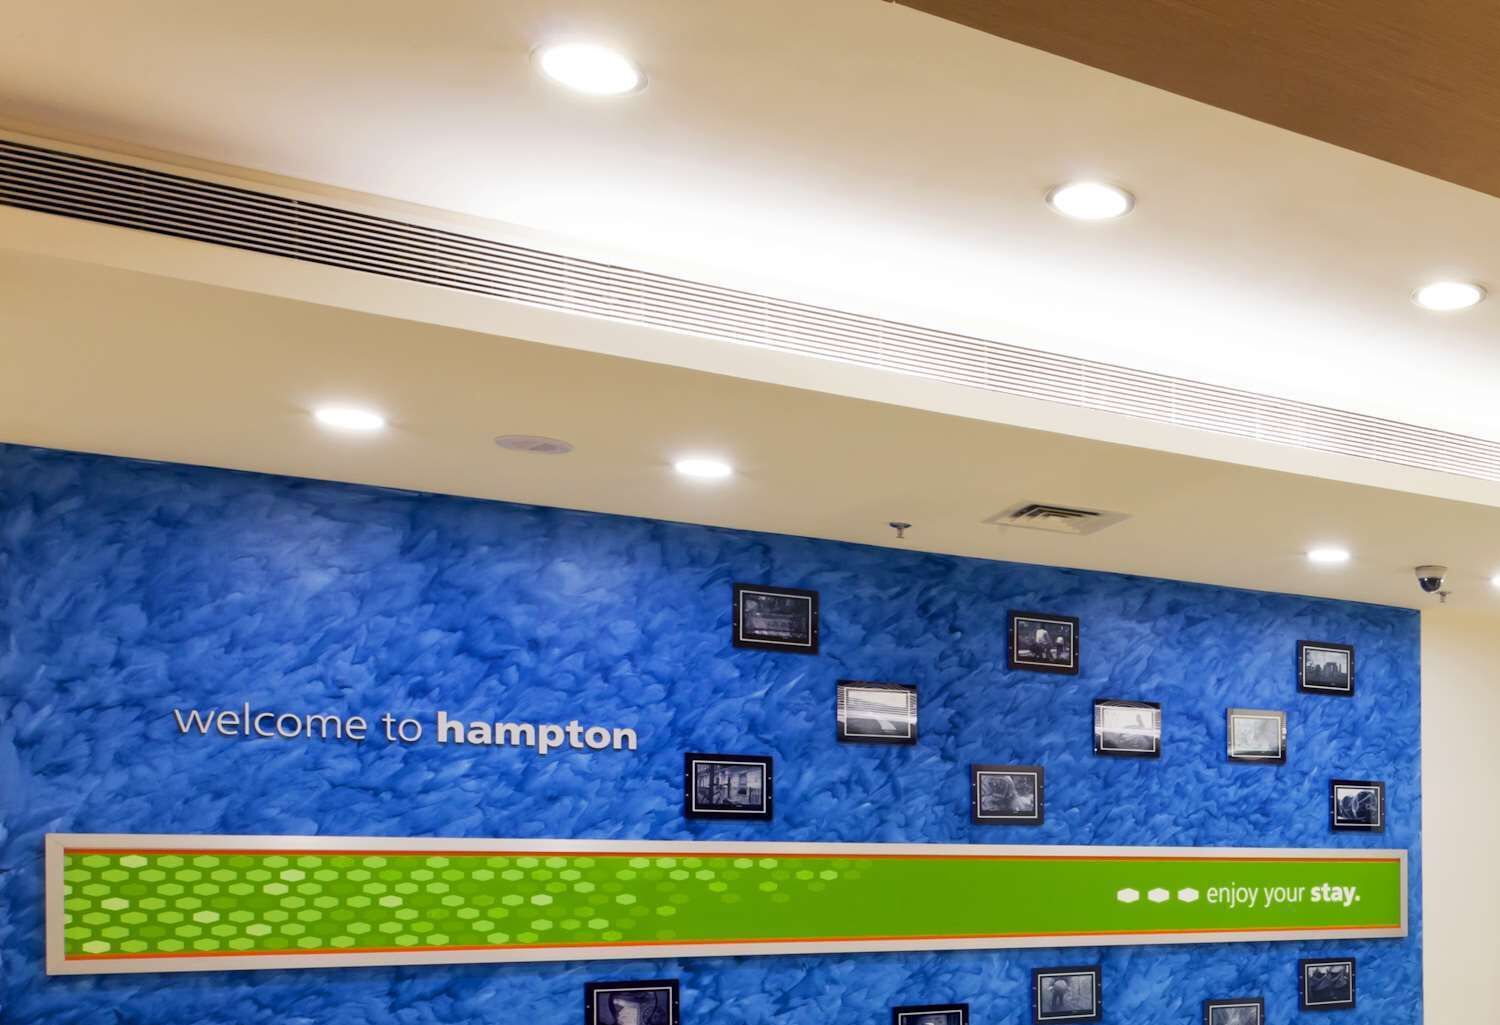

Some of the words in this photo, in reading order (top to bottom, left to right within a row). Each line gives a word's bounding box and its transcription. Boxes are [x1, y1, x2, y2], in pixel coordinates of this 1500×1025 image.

[173, 702, 368, 740] welcome
[381, 712, 421, 743] to
[437, 711, 638, 755] hampton
[1206, 882, 1259, 908] enjoy
[1264, 886, 1306, 908] your
[1310, 883, 1360, 907] stay.
